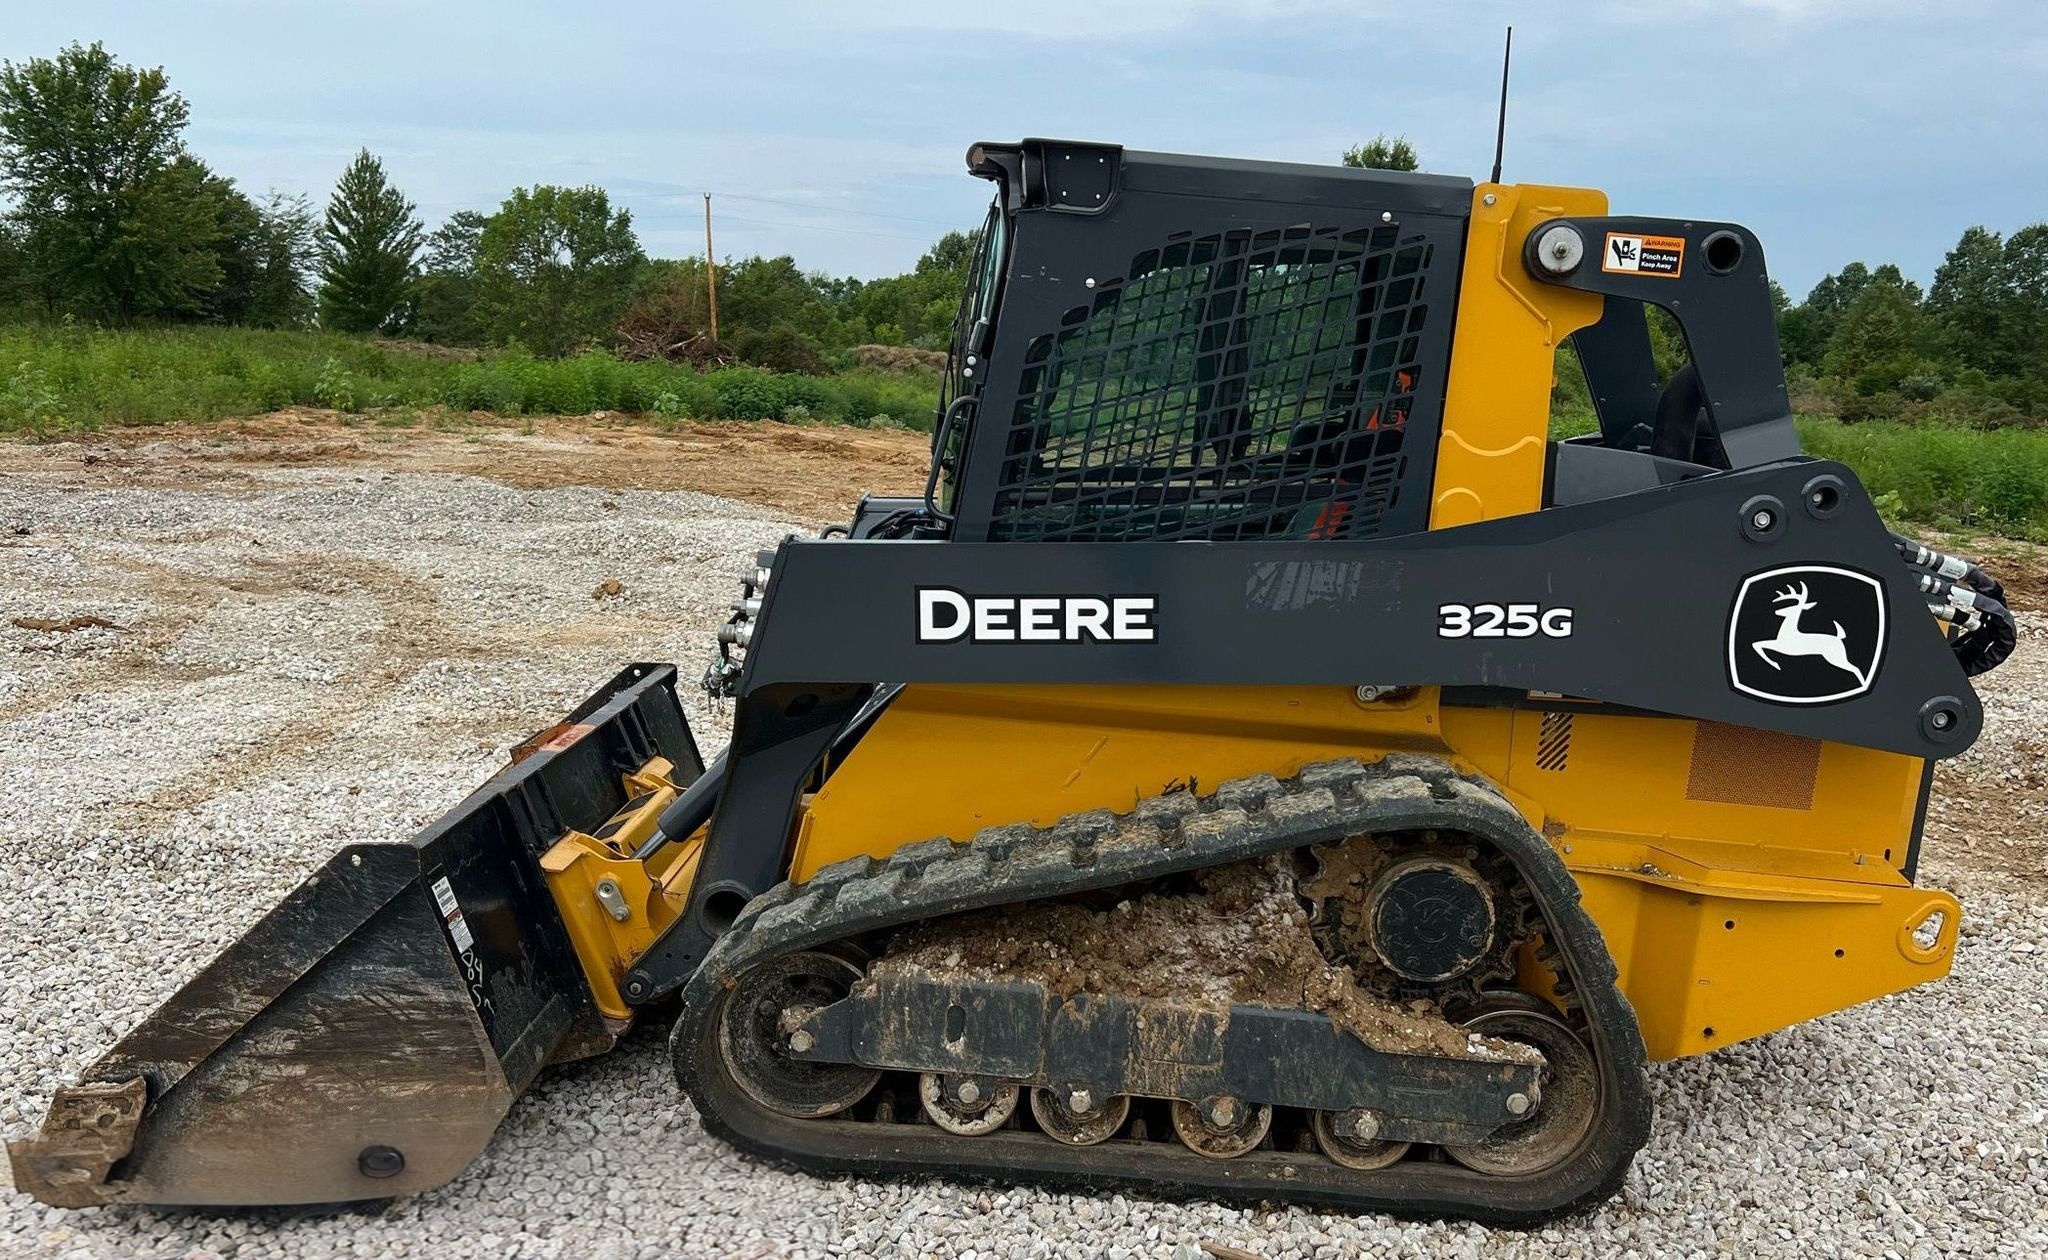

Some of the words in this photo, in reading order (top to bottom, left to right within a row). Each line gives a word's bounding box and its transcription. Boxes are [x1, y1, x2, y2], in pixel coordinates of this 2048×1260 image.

[1651, 240, 1680, 248] WARNING
[1642, 252, 1661, 260] Pinch
[918, 588, 1155, 641] DEERE
[1438, 603, 1573, 638] 325G
